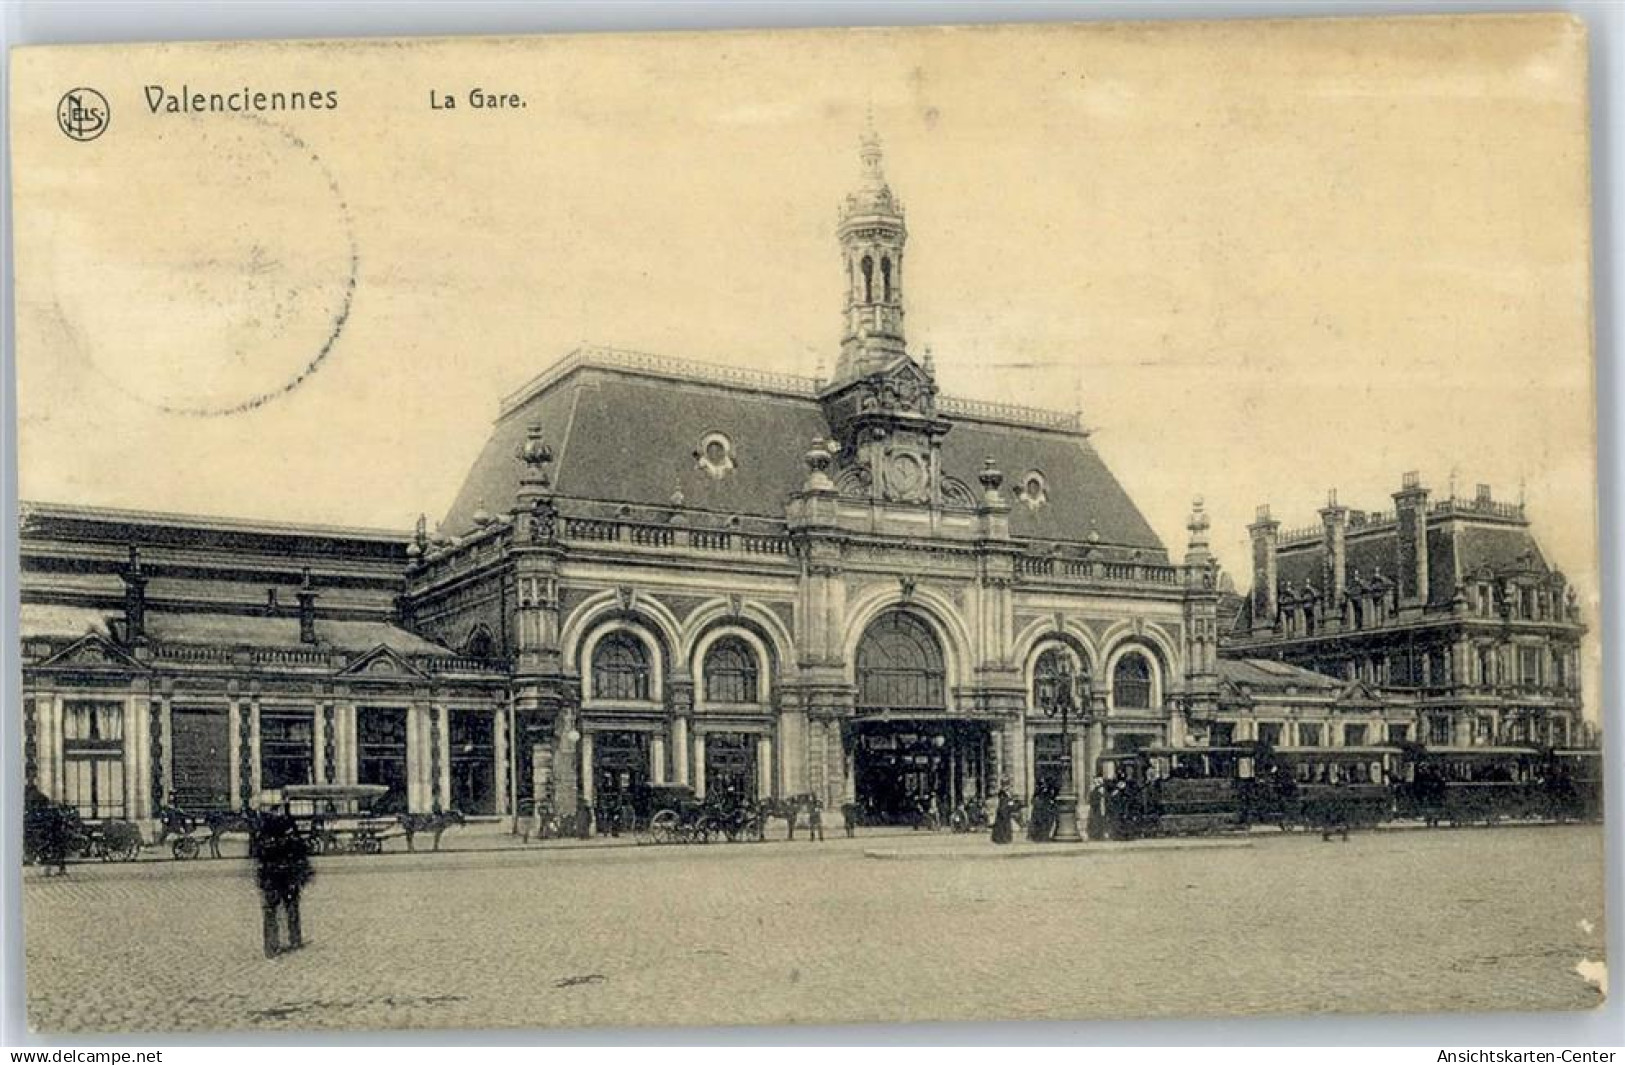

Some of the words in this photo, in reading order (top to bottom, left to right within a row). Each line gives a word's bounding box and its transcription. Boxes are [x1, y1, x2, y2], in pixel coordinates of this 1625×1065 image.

[144, 84, 338, 113] Valenciennes
[430, 90, 456, 109] La
[469, 88, 527, 109] Gare.
